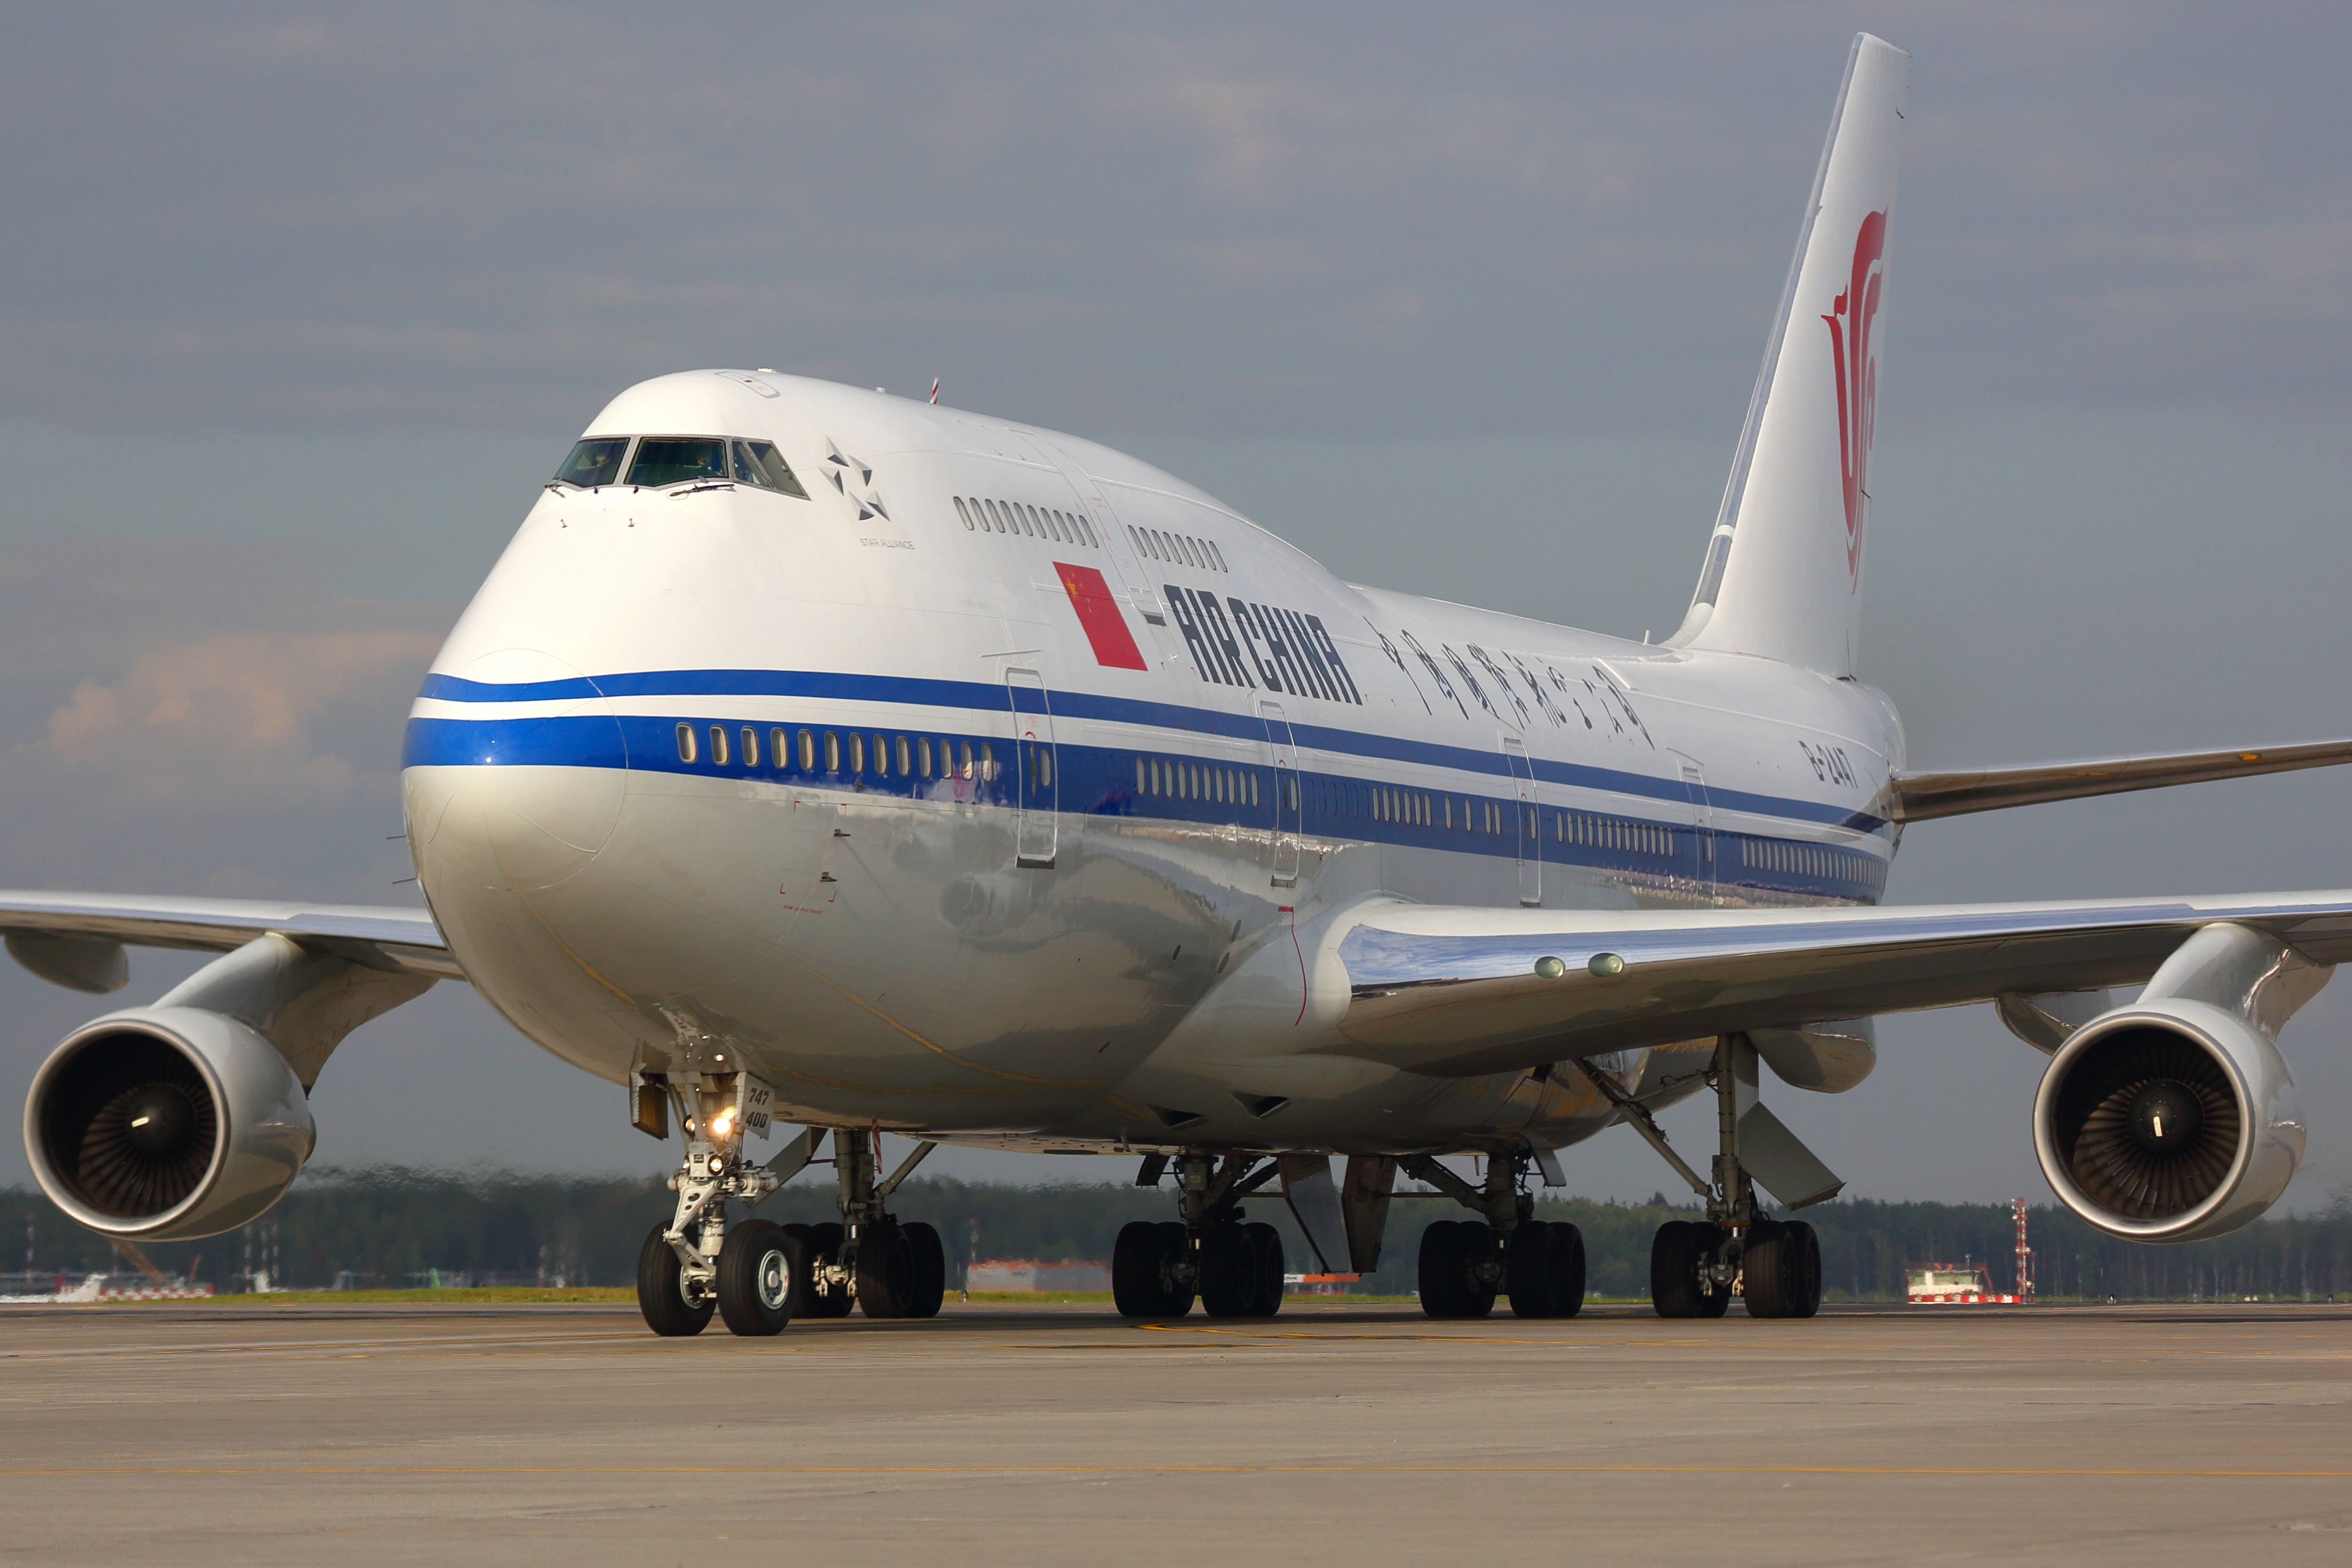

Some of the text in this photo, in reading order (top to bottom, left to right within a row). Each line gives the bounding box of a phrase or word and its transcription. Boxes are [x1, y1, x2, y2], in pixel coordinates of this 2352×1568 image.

[859, 538, 915, 550] STAR ALLIANCE
[1164, 584, 1363, 706] AIR CHINA
[1798, 740, 1859, 790] B-2447
[748, 1087, 770, 1107] 747
[745, 1111, 769, 1128] 400
